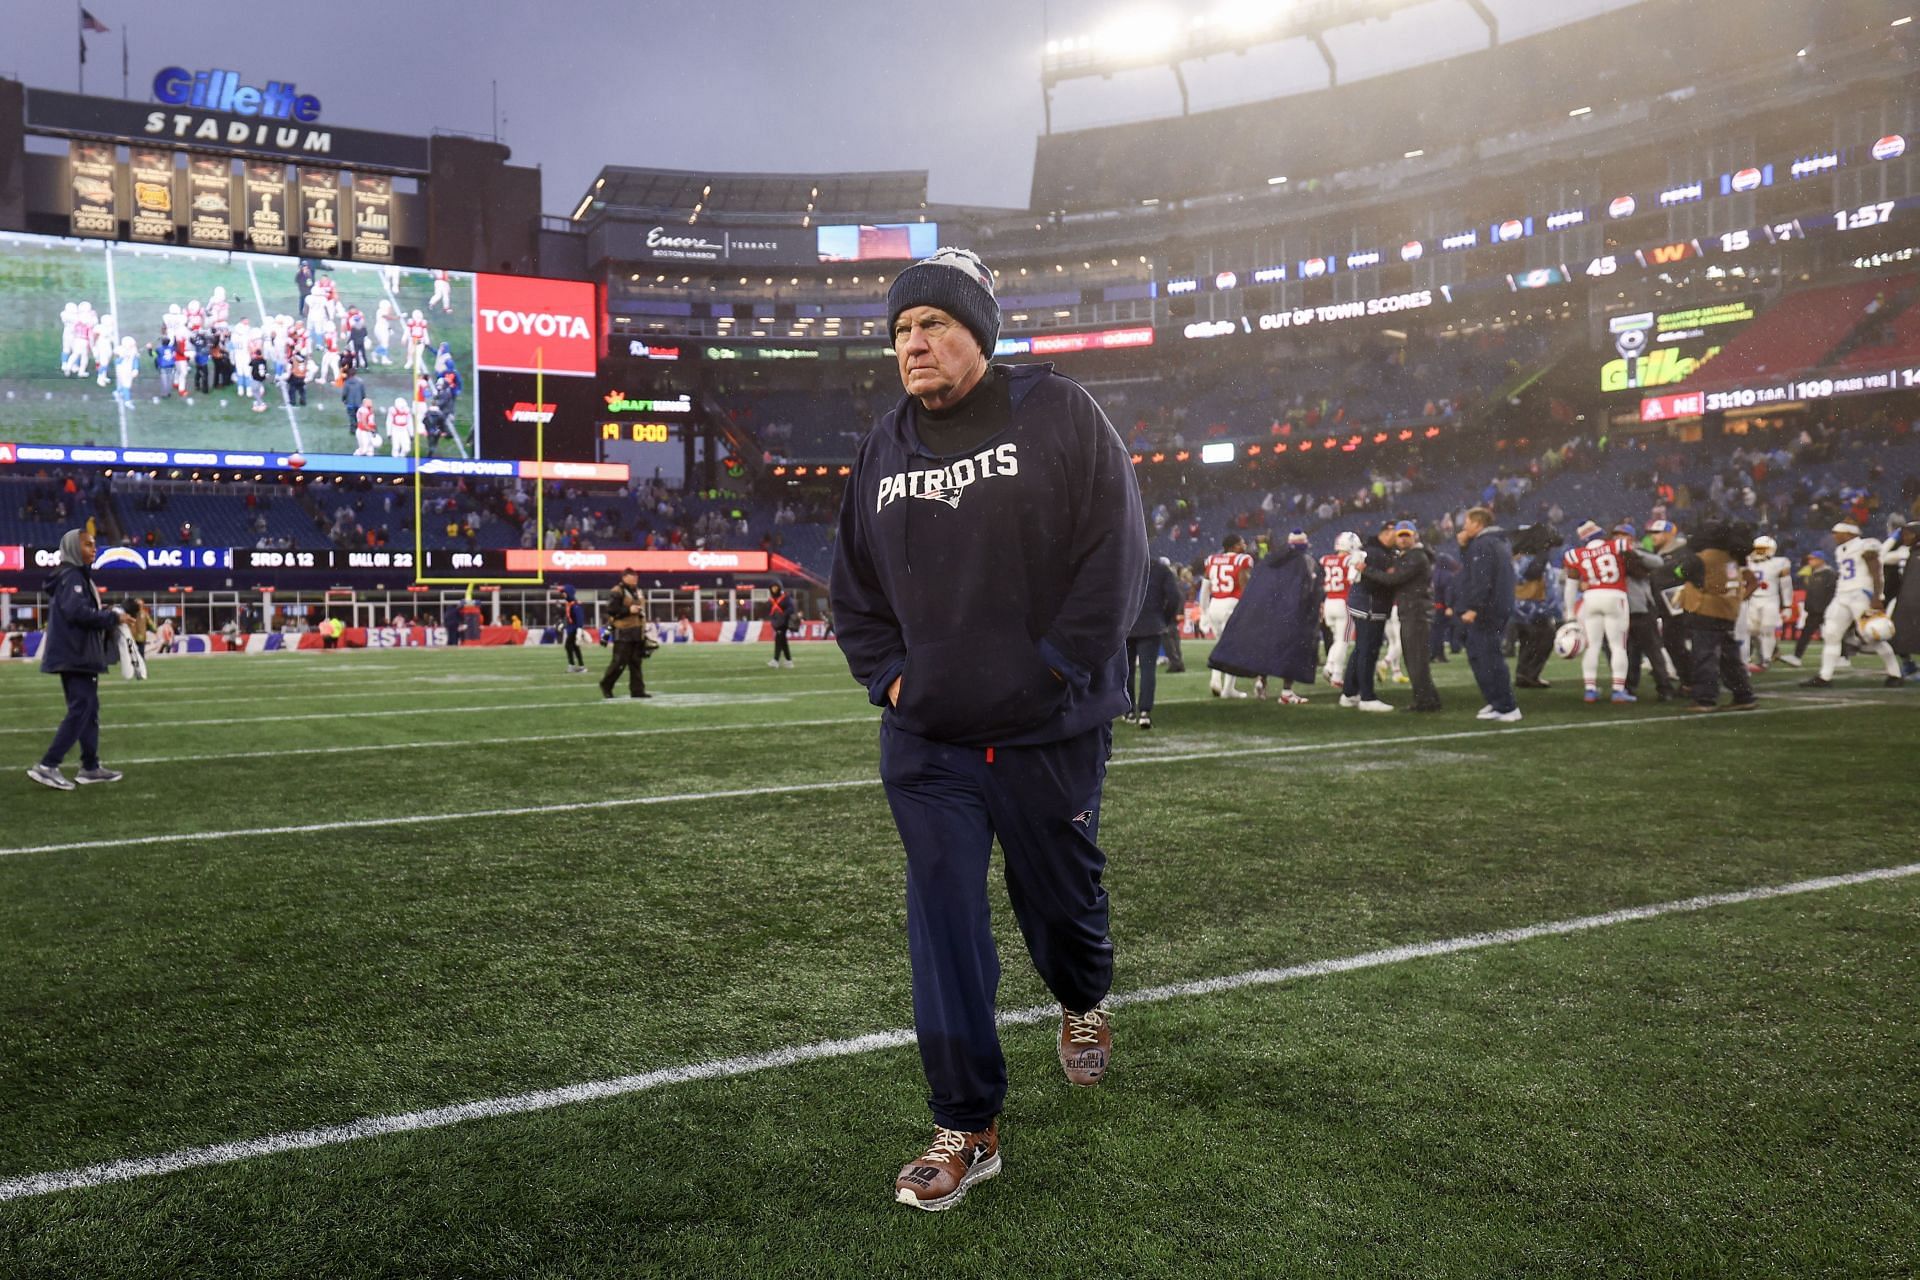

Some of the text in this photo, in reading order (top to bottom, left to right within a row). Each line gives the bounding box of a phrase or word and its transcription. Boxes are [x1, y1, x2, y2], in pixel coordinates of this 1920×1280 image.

[153, 66, 321, 121] Gillette
[144, 112, 331, 152] STADIUM
[76, 218, 114, 231] 2001
[1834, 200, 1896, 231] 1:57
[192, 228, 230, 240] 2004
[251, 234, 283, 246] 2014
[646, 226, 723, 250] Encore
[1719, 230, 1750, 252] 15
[358, 243, 389, 255] 2018
[652, 249, 685, 258] BOSTON
[731, 241, 778, 249] TERRACE
[1585, 255, 1618, 277] 45
[1259, 290, 1432, 330] OUT OF TOWN SCORES
[479, 309, 591, 340] TOYOTA
[1706, 389, 1756, 411] 31:10
[1796, 378, 1833, 399] 109
[1673, 396, 1699, 414] NE
[633, 423, 668, 443] 0:00
[876, 442, 1019, 514] PATRIOTS
[148, 550, 183, 567] LAC
[202, 550, 217, 567] 6
[250, 552, 315, 567] 3RD & 12
[393, 552, 414, 567] 22
[471, 553, 483, 568] 4
[551, 550, 607, 569] Optum
[687, 551, 739, 569] Optum
[1581, 554, 1620, 585] 18
[366, 627, 418, 647] EST.
[909, 1166, 940, 1182] 10
